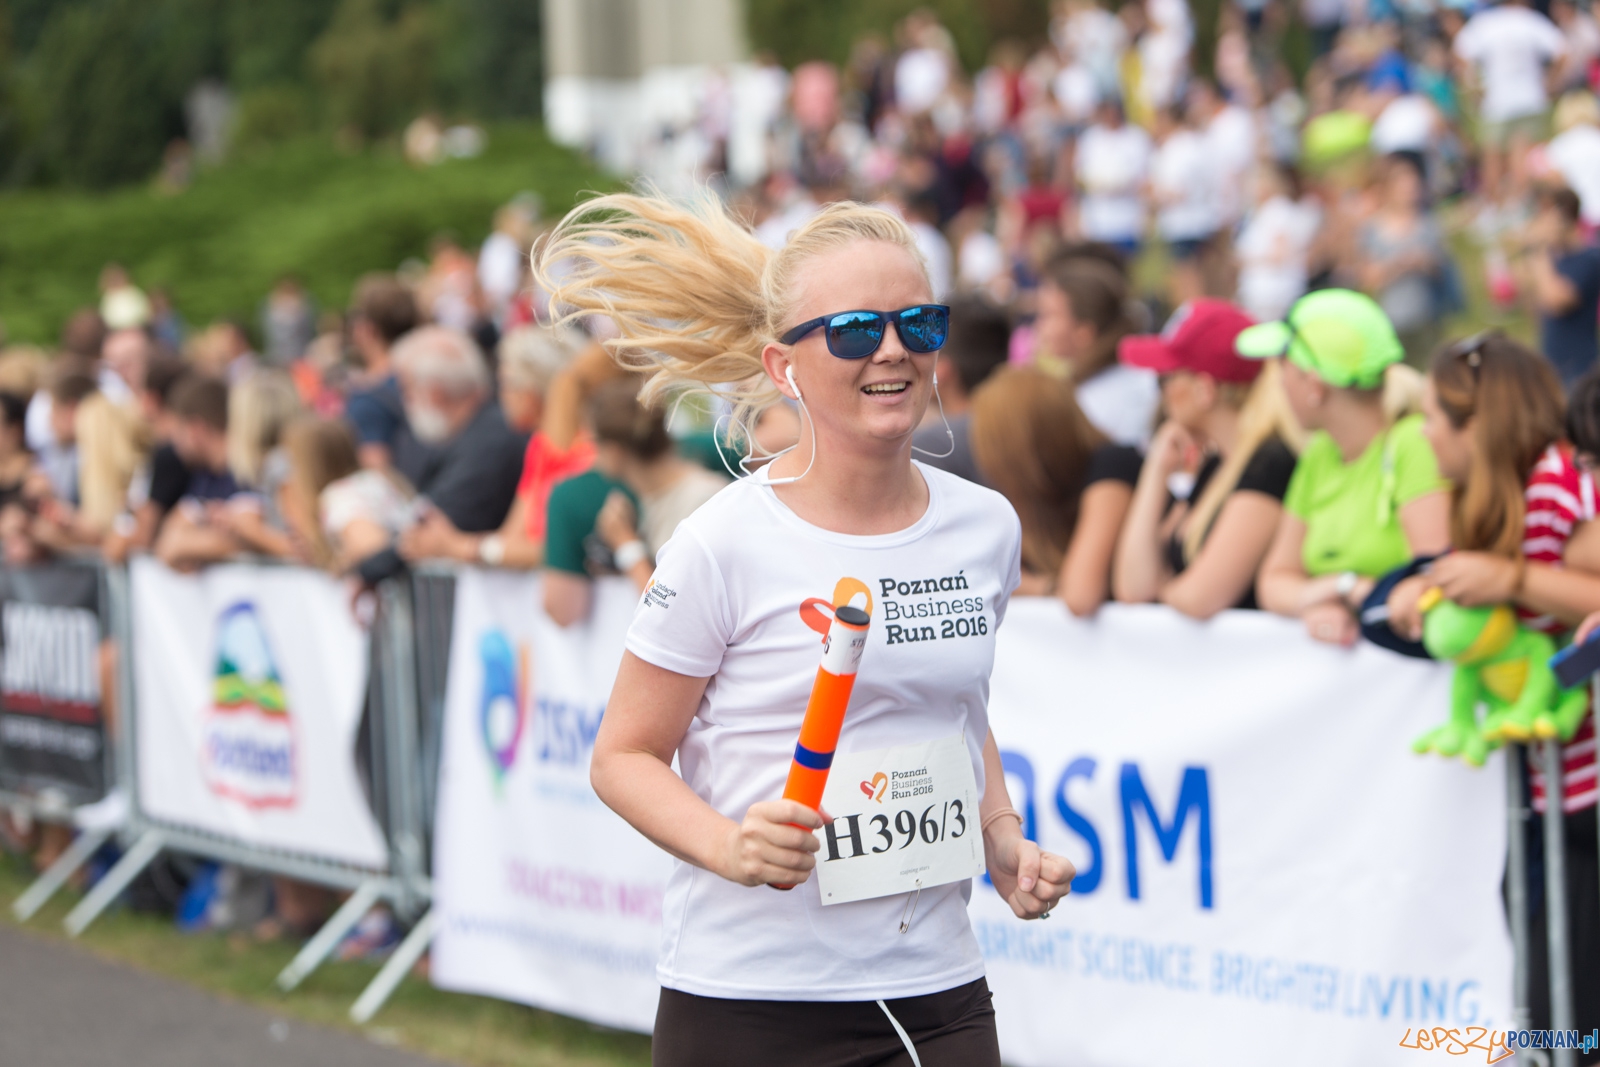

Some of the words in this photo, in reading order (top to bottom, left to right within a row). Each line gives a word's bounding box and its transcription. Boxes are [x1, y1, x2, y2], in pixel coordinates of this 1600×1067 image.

[879, 570, 969, 597] Poznań
[882, 597, 983, 621] Business
[886, 623, 936, 645] Run
[940, 616, 988, 639] 2016
[891, 766, 928, 780] Poznań
[891, 777, 933, 790] Business
[891, 790, 911, 800] Run
[912, 785, 934, 796] 2016
[824, 799, 966, 862] H396/3
